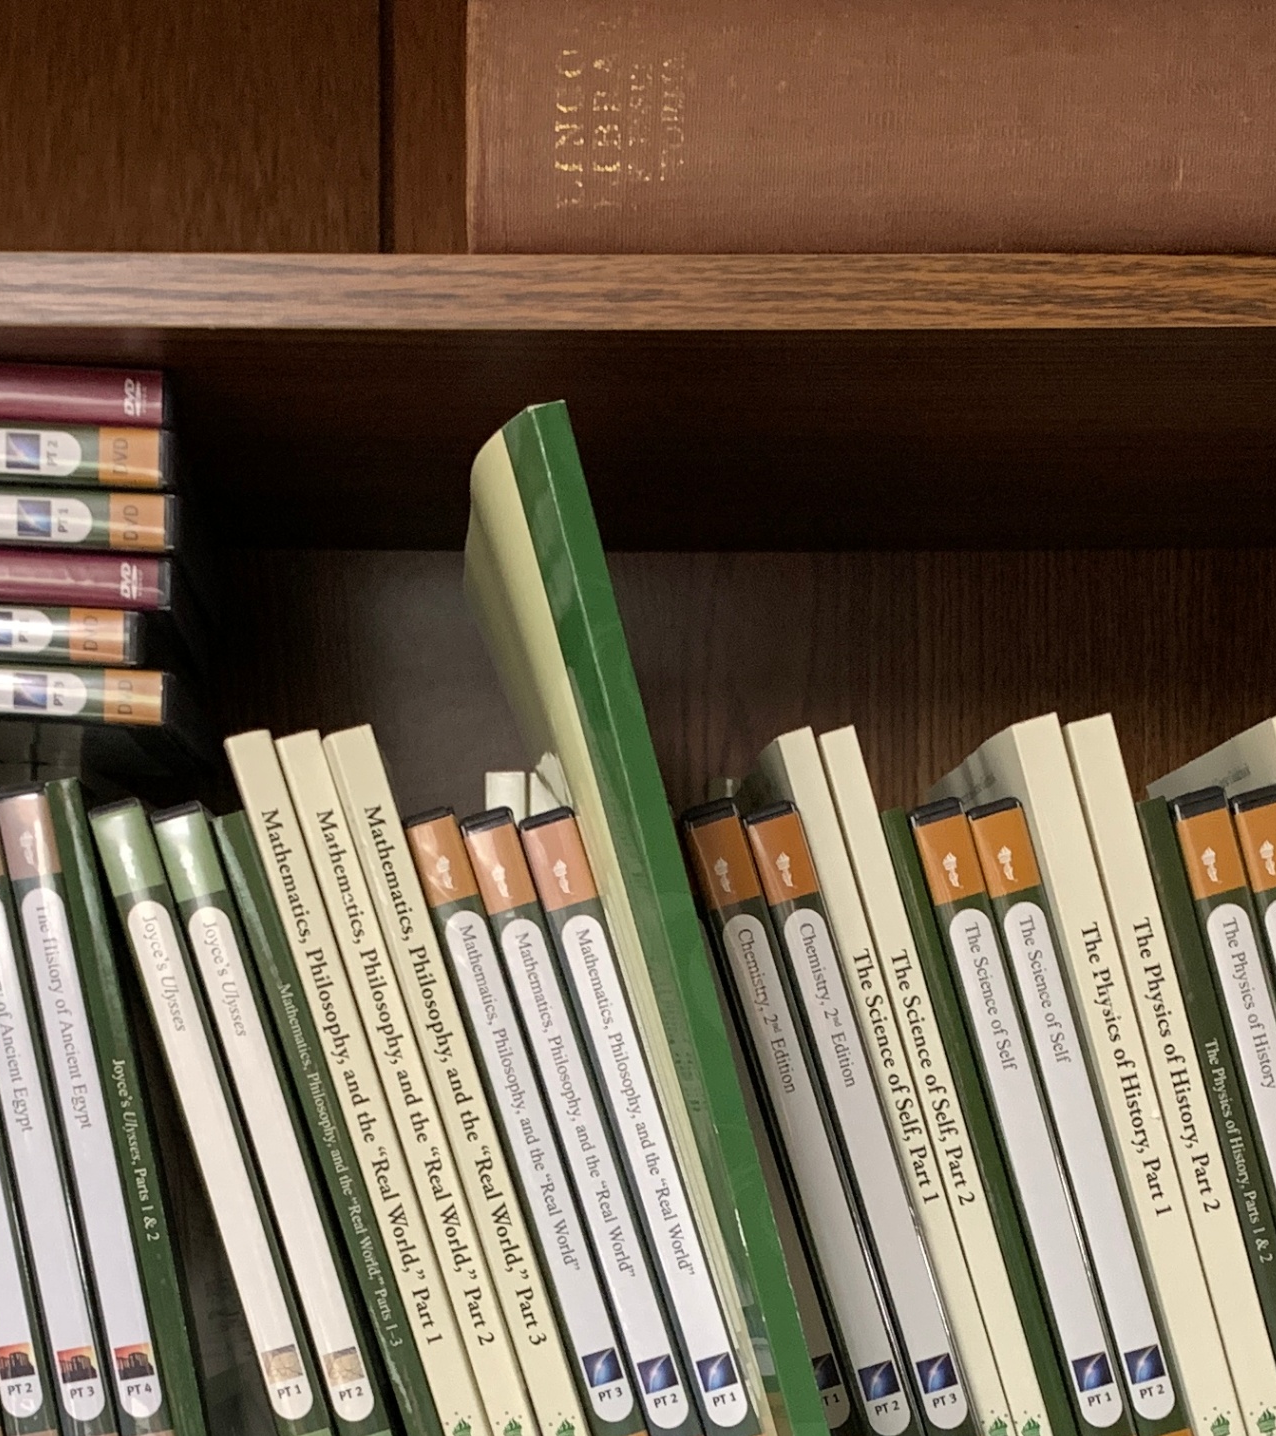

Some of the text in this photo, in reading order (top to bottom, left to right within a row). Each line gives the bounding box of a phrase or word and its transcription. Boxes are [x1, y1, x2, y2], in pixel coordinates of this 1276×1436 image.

[363, 804, 414, 943] Mathematics,
[407, 944, 455, 1064] Philosophy,
[798, 921, 832, 1007] Chemistry,
[829, 1030, 857, 1089] Edition
[445, 1066, 475, 1107] and
[121, 1110, 142, 1167] Ulysses,
[459, 1109, 481, 1143] the
[132, 1166, 150, 1203] Parts
[140, 1204, 155, 1213] 1
[142, 1214, 159, 1231] &
[145, 1231, 161, 1243] 2
[514, 1285, 539, 1330] Part
[527, 1332, 549, 1347] 3
